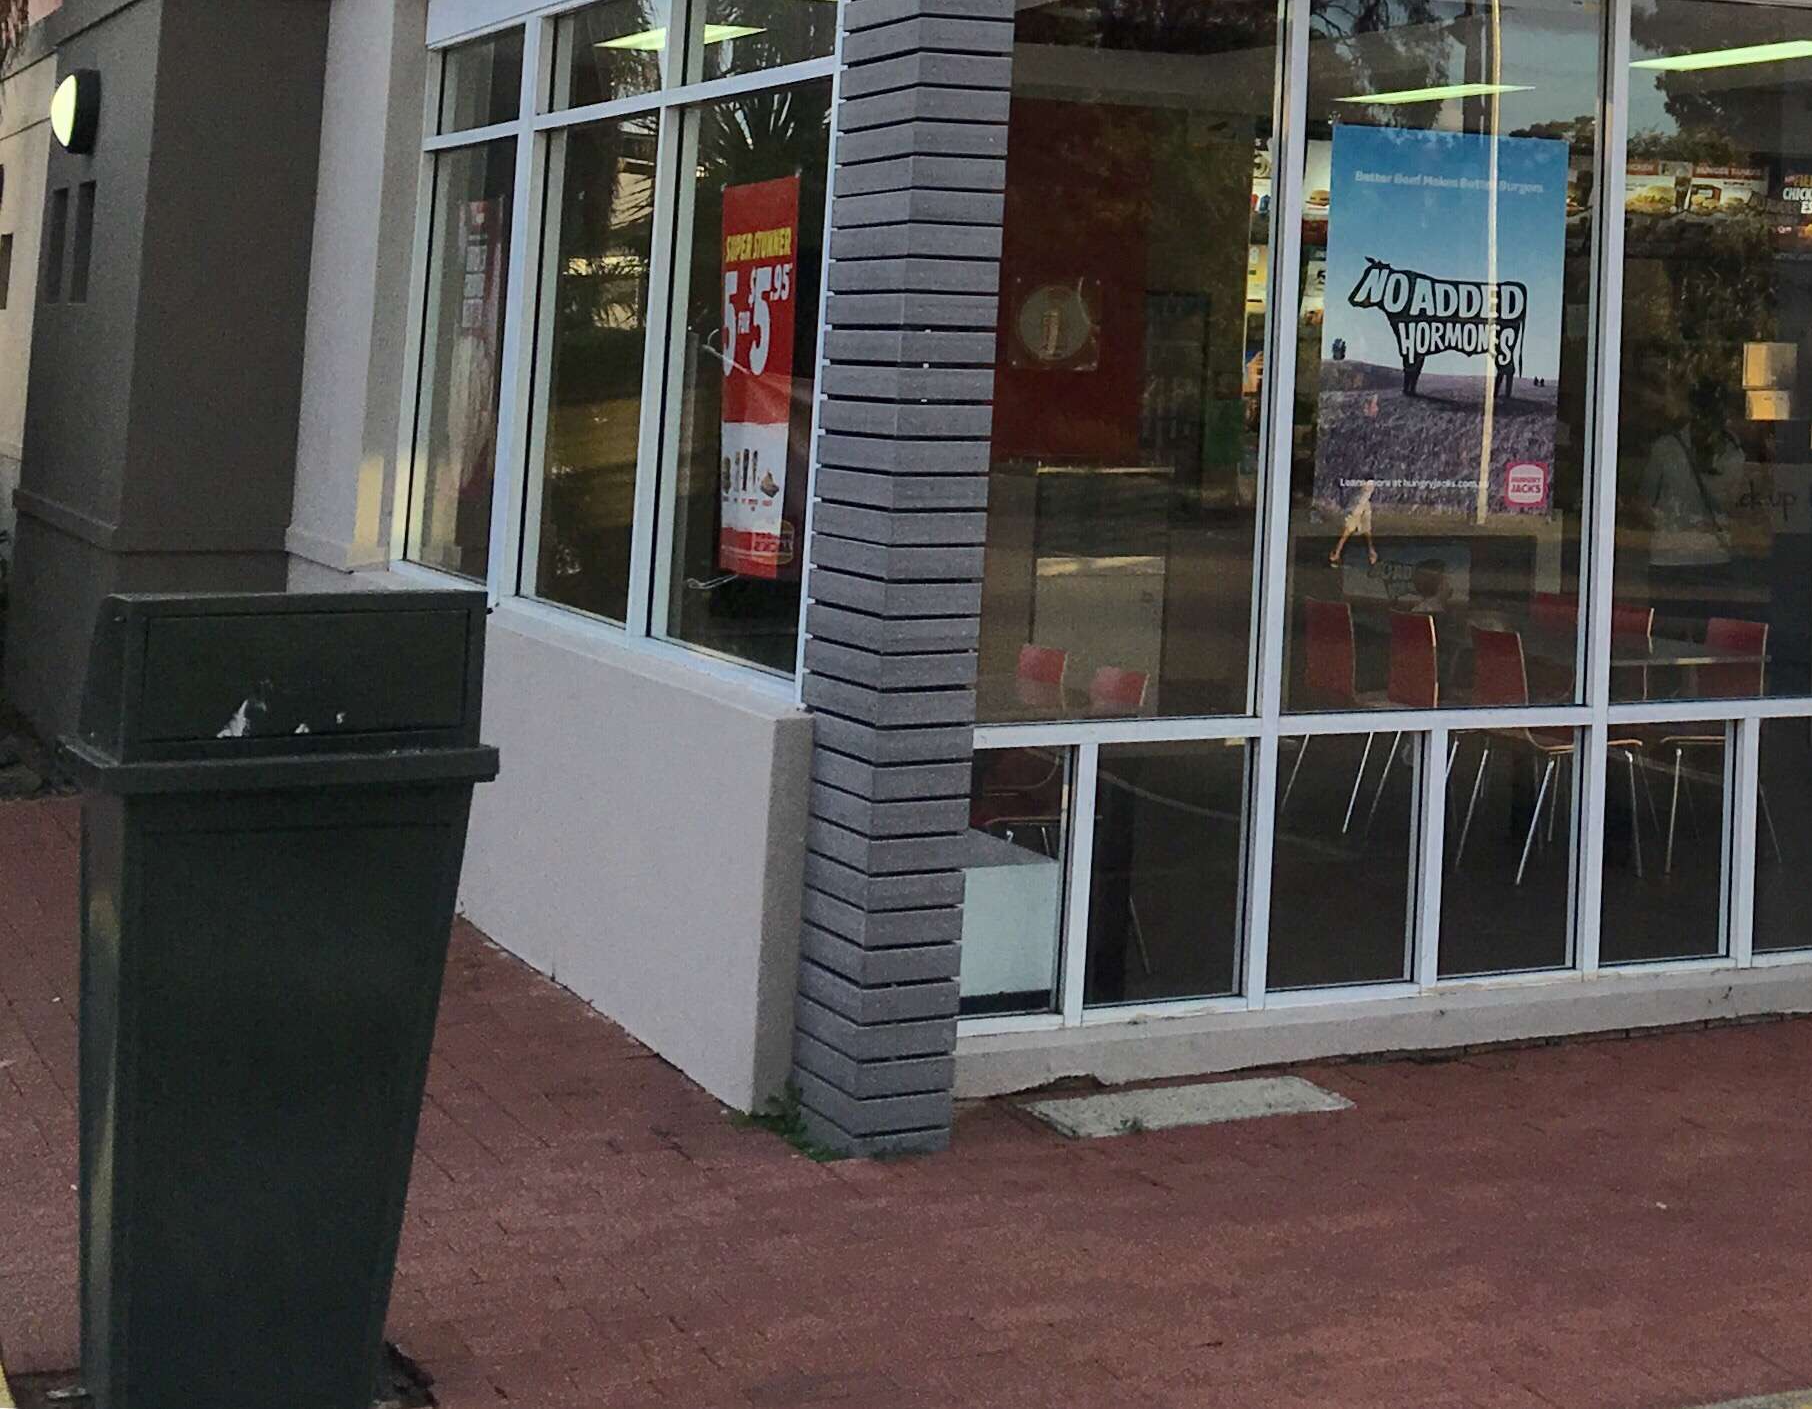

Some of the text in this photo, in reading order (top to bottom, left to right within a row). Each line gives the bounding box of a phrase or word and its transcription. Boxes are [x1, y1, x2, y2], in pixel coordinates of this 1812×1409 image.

[1354, 268, 1525, 320] NO ADDED
[1399, 321, 1516, 366] HORMONES
